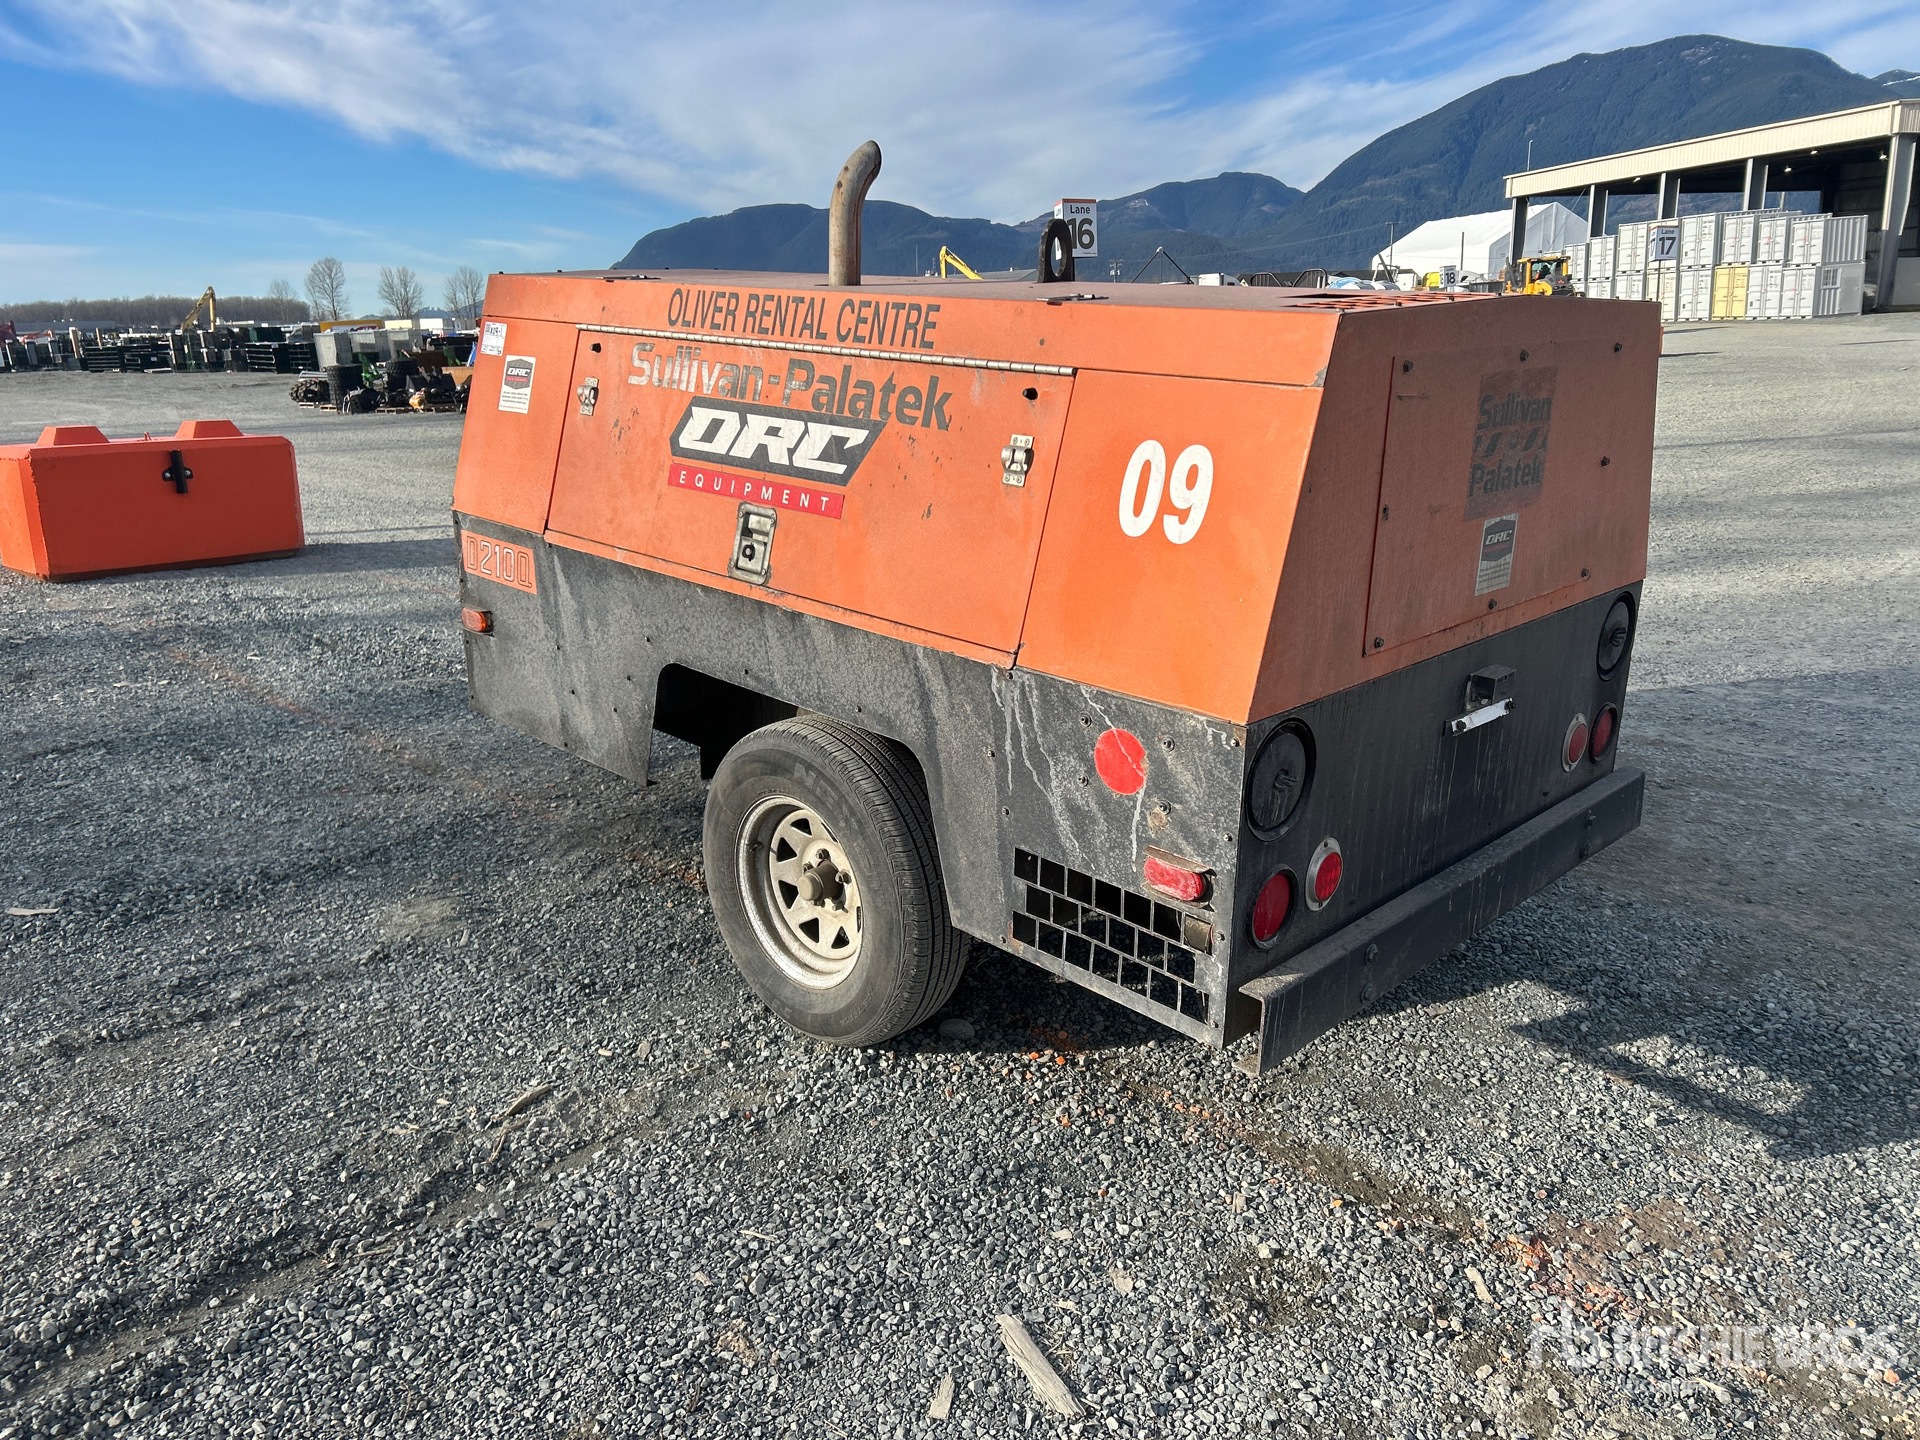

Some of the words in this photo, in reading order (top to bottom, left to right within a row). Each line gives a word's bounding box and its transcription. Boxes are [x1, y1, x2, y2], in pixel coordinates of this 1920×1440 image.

[1069, 204, 1091, 215] Lane
[1066, 217, 1095, 250] 16
[1659, 236, 1677, 255] 17
[1445, 271, 1456, 285] 18
[667, 287, 740, 332] OLIVER
[742, 293, 828, 341] RENTAL
[835, 298, 942, 350] CENTRE
[627, 341, 954, 432] Sullivan-Palatek
[1477, 391, 1553, 432] Sullivan
[679, 470, 830, 512] EQUIPMENT
[1118, 439, 1214, 545] 09
[1468, 457, 1543, 498] Palatek
[466, 535, 533, 589] D210Q
